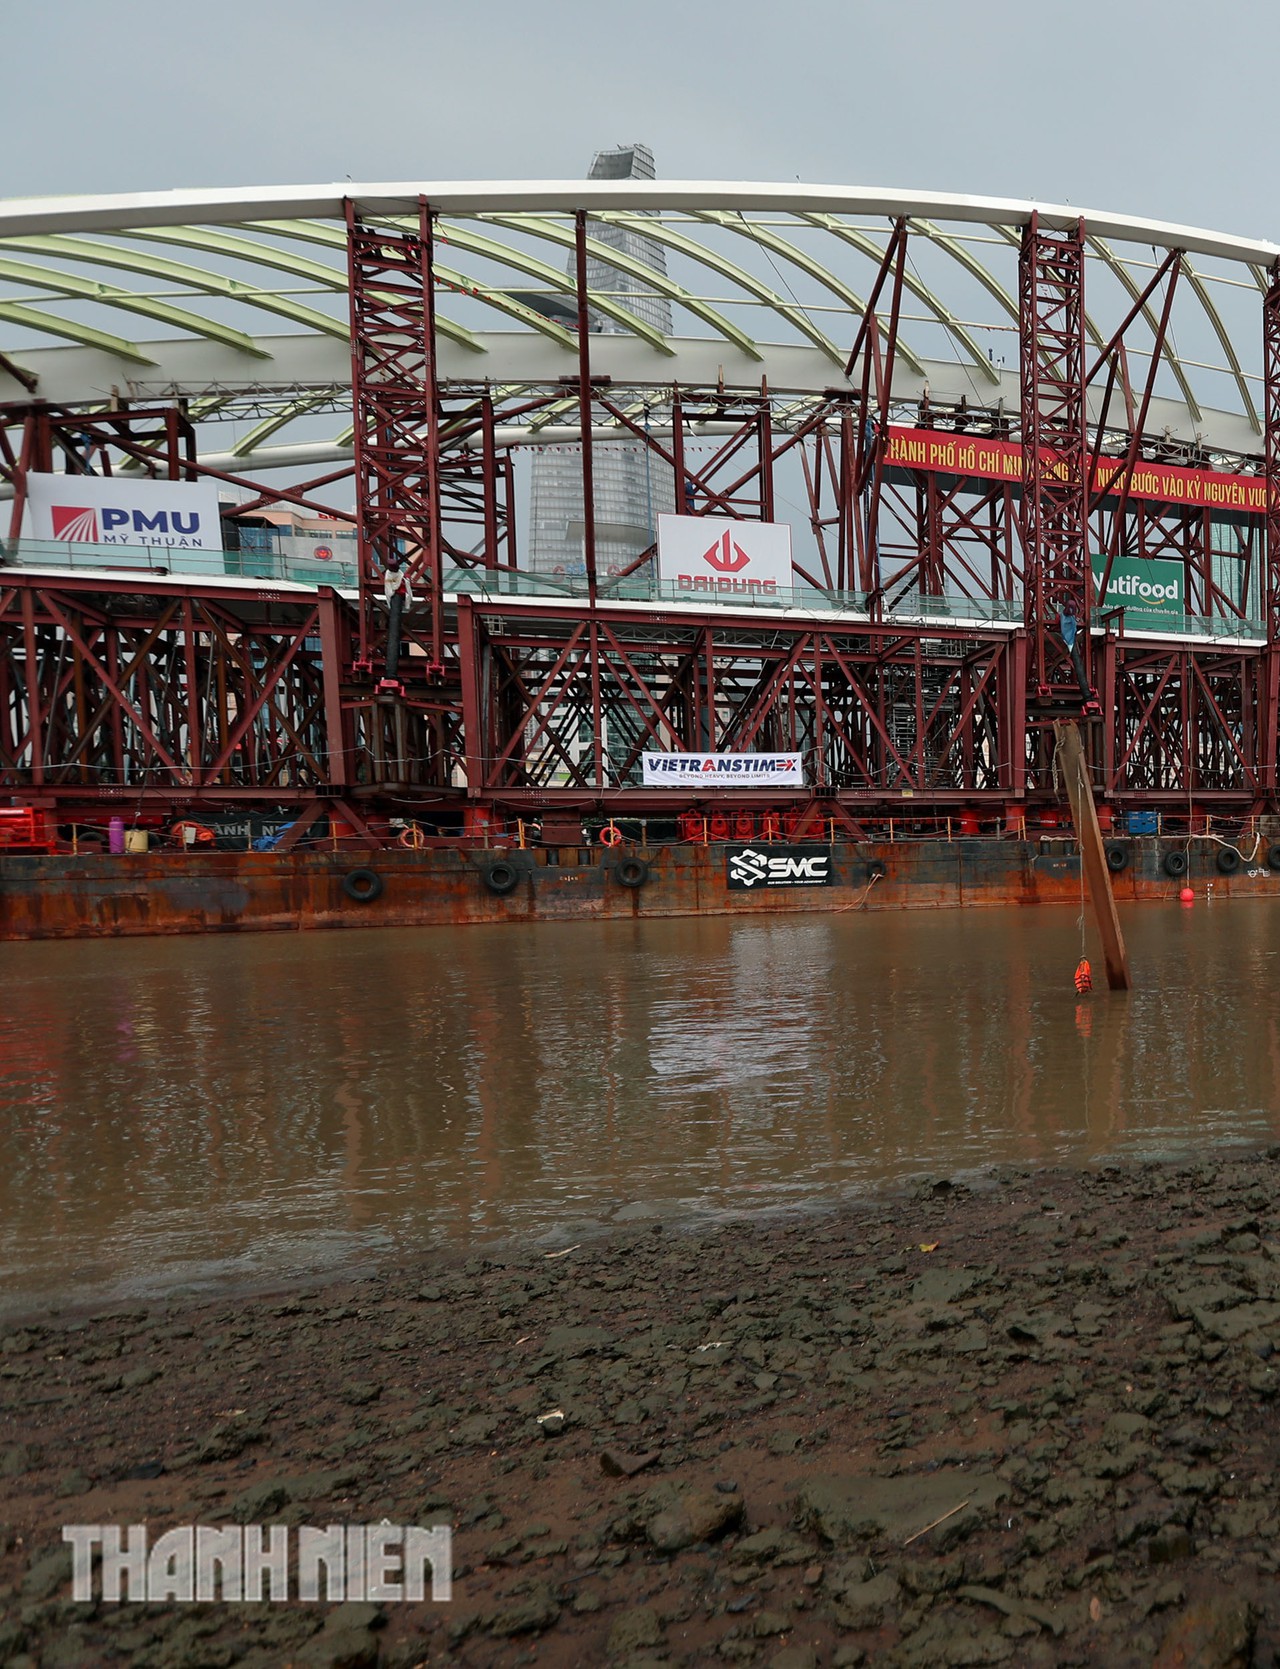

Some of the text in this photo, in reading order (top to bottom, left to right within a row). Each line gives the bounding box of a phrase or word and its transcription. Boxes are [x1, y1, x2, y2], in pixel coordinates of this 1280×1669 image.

[883, 435, 926, 463] HÀNH
[930, 441, 957, 467] PHỐ
[959, 443, 976, 470] HỒ
[979, 449, 1000, 473] CHÍ
[1130, 470, 1160, 494] BƯỚC
[1162, 472, 1184, 498] VÀO
[1186, 475, 1201, 499] KỶ
[1203, 482, 1246, 505] NGUYÊN
[101, 508, 200, 535] PMU
[104, 533, 203, 549] MỸ THUẬN
[648, 758, 798, 772] VIETRANSTIMEX
[768, 857, 828, 878] SMC
